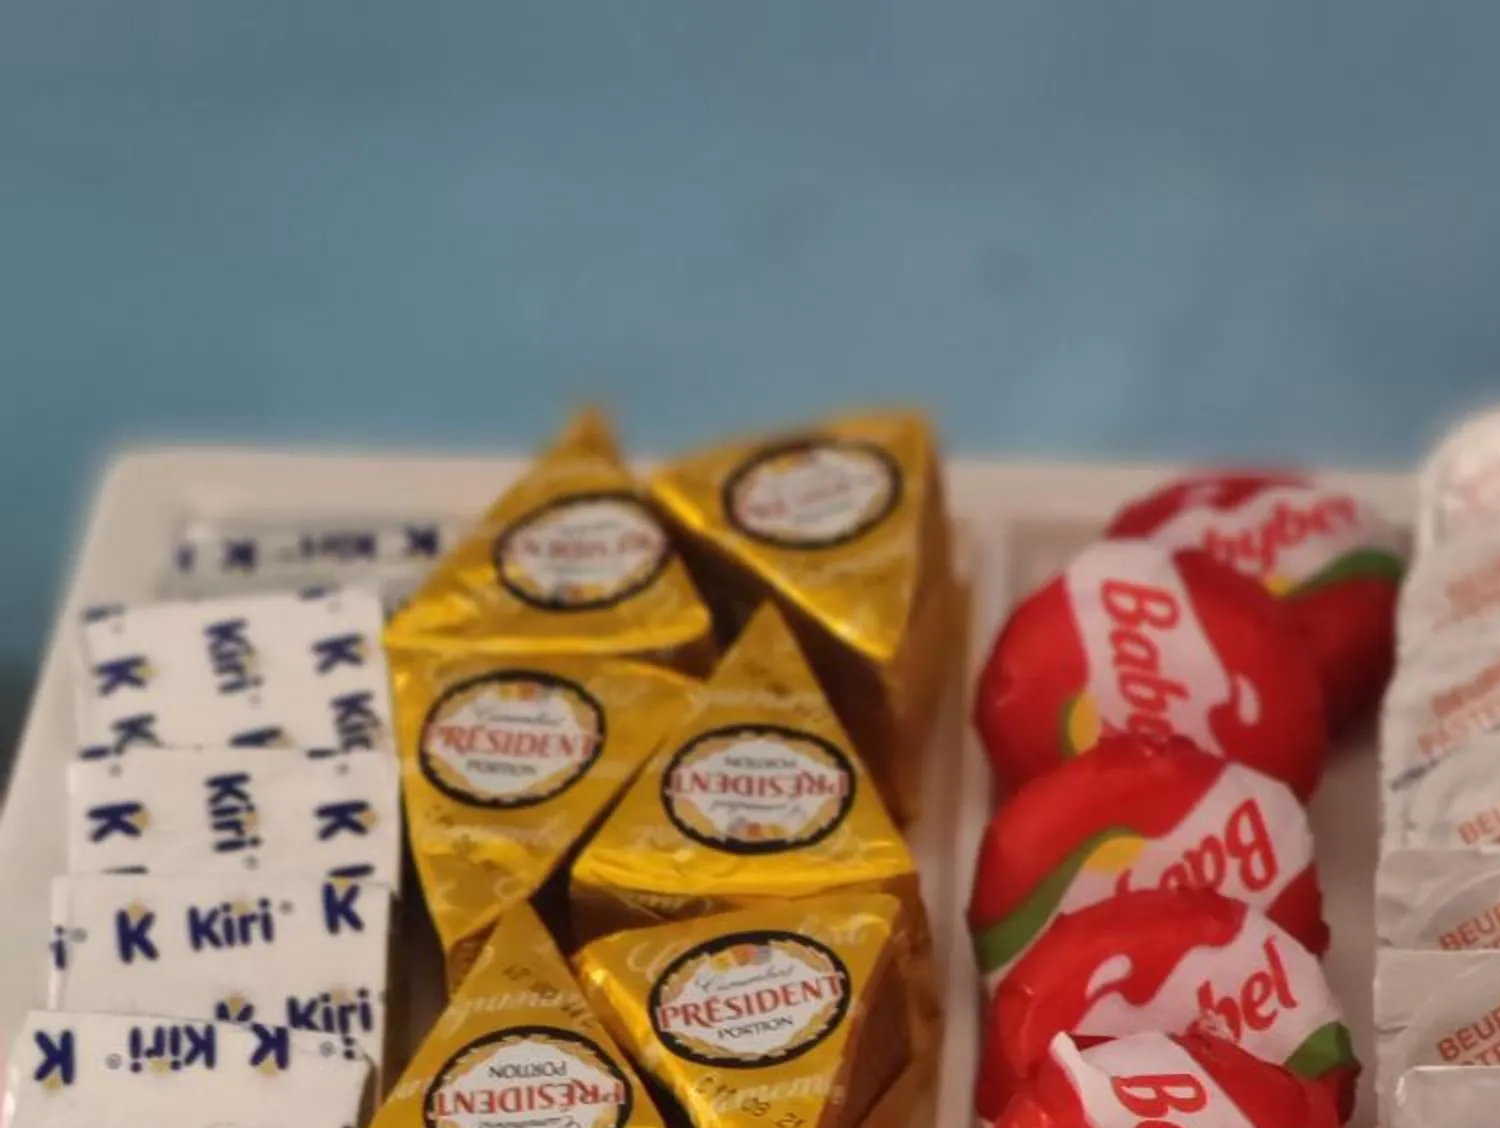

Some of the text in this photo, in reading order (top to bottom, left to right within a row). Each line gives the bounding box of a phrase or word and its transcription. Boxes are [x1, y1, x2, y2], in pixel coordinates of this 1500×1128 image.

[95, 656, 151, 695] K
[205, 619, 262, 694] Kiri
[312, 633, 367, 674] K
[86, 801, 146, 842] K
[205, 772, 262, 853] Kiri
[315, 800, 371, 841] K
[115, 881, 365, 965] K Kiri K
[286, 987, 374, 1035] Kiri
[34, 1029, 74, 1086] K
[129, 1023, 216, 1073] Kiri
